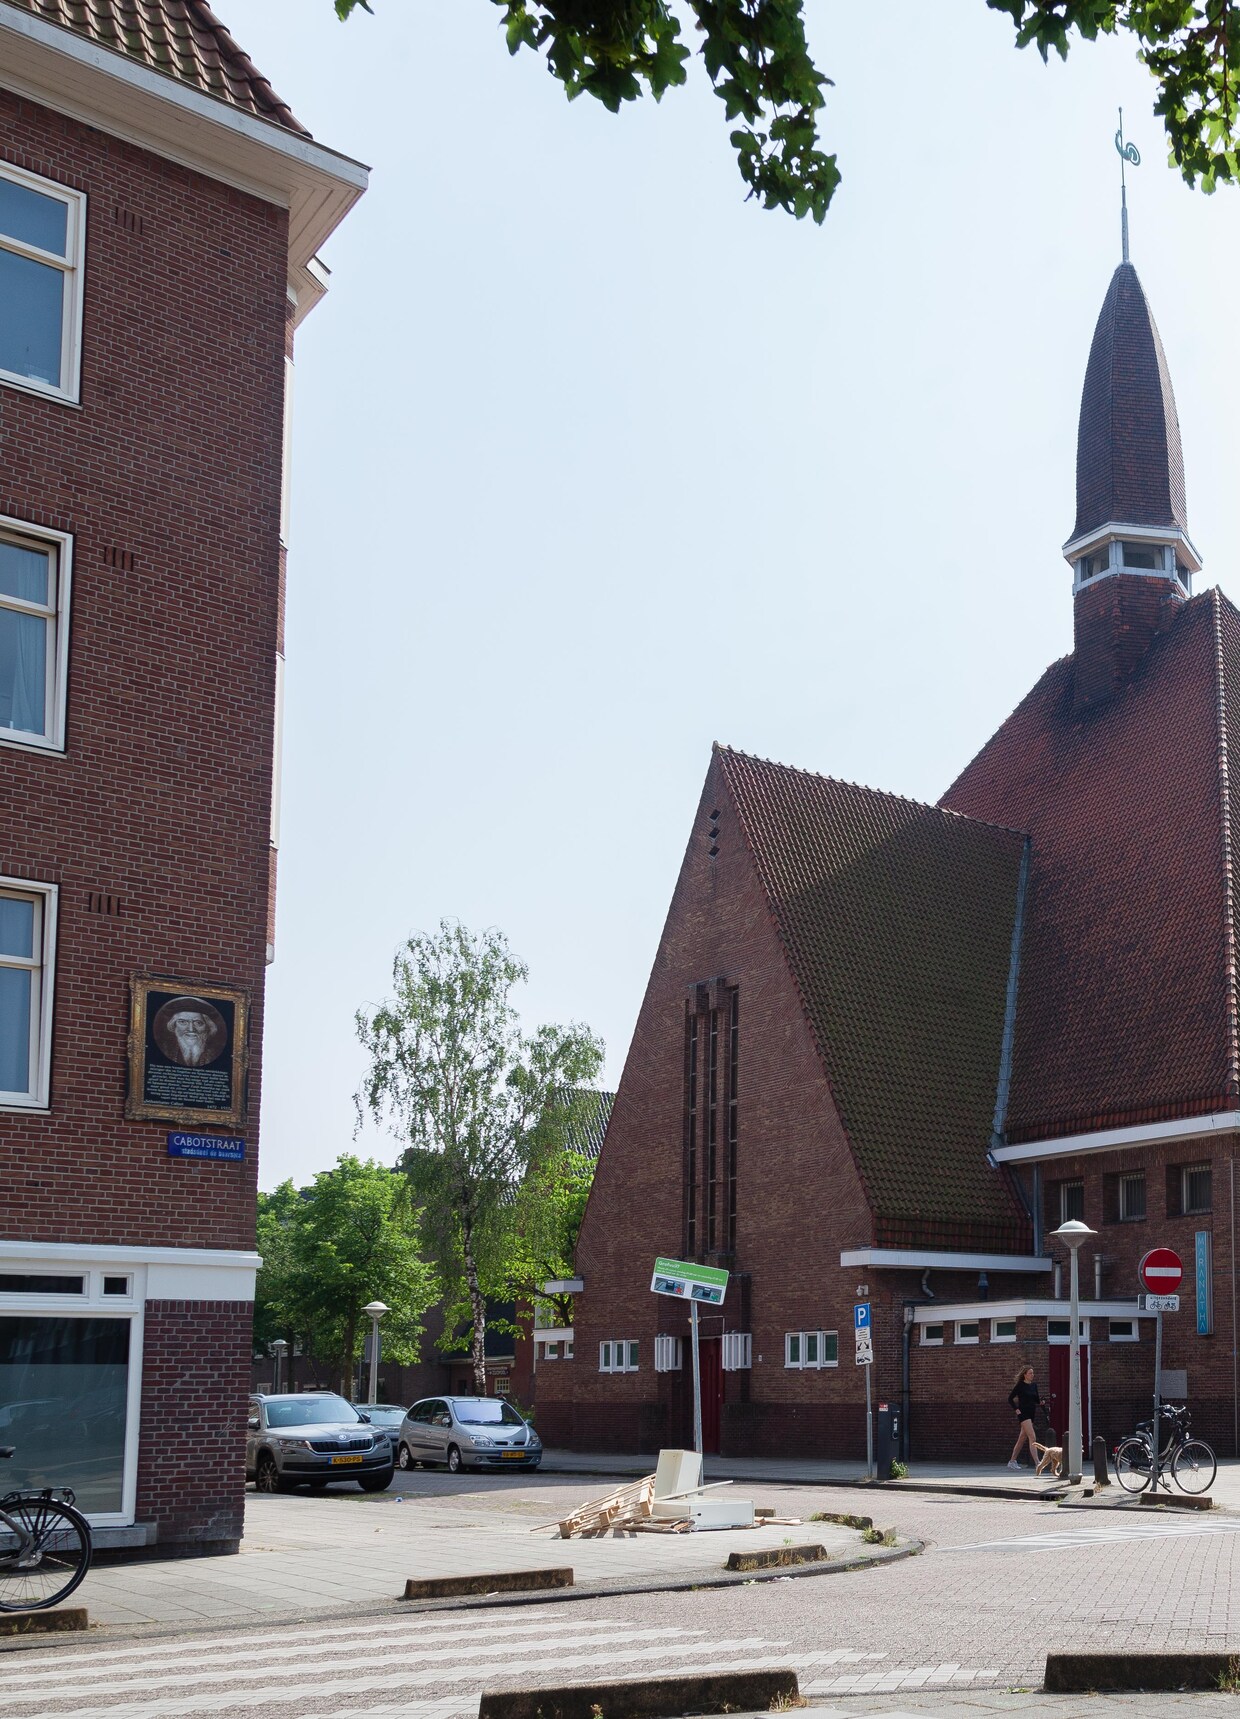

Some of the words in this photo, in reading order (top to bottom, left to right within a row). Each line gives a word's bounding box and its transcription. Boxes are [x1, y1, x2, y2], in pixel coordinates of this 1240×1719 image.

[174, 1136, 241, 1150] CABOTSTRAAT
[1197, 1237, 1206, 1330] MARANATHA
[858, 1308, 866, 1325] P
